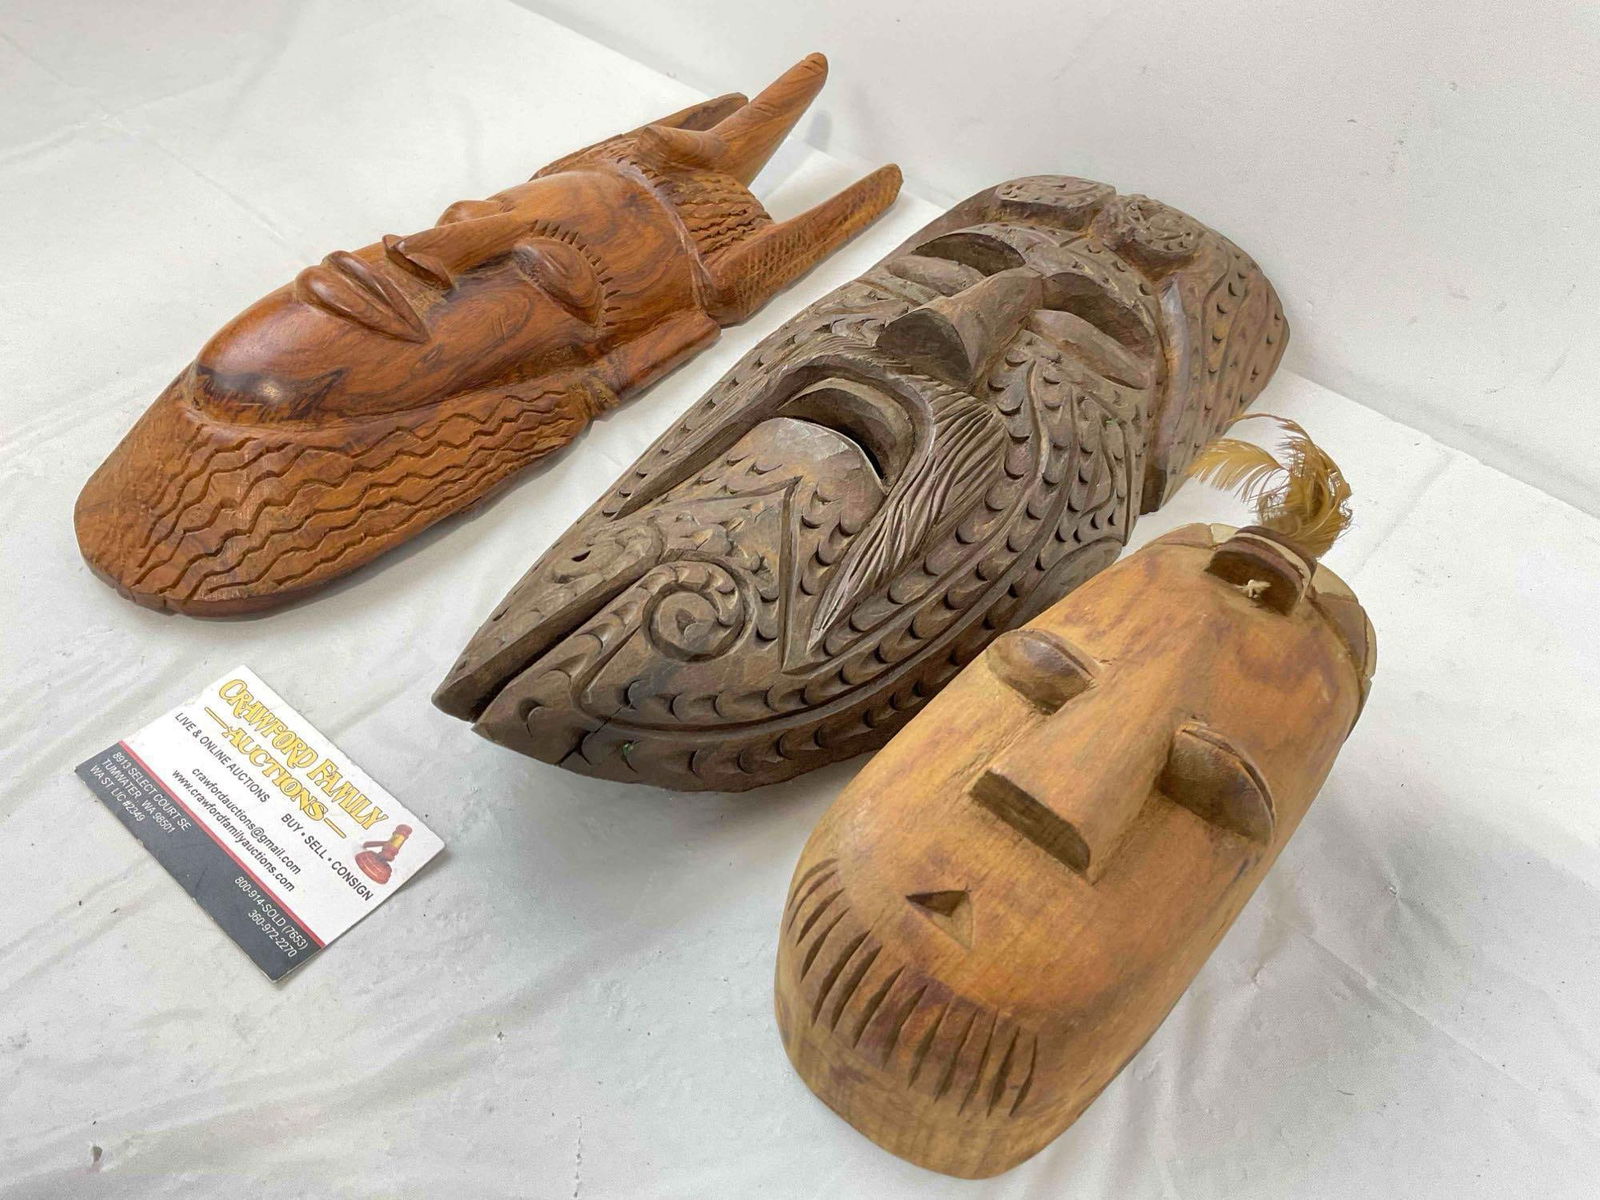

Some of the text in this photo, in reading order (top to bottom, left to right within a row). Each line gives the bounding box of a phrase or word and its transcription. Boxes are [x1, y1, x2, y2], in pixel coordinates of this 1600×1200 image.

[90, 765, 105, 780] WA
[122, 800, 145, 822] #2349
[112, 752, 191, 831] 8913 SELECT COURT SE
[175, 712, 270, 803] LIVE & ONLINE AUCTIONS
[219, 679, 389, 830] CRAWFORD FAMILY
[222, 726, 328, 821] AUCTIONS
[141, 799, 156, 815] WA
[152, 813, 176, 833] 98501
[172, 770, 295, 892] www.crawfordfamilyauctions.com
[192, 768, 301, 875] crawfordauctions@gmail.com
[281, 813, 374, 901] BUY SELL CONSIGN
[234, 876, 309, 950] 800-914-SOLD (7653)
[248, 910, 298, 958] 360-972-2270
